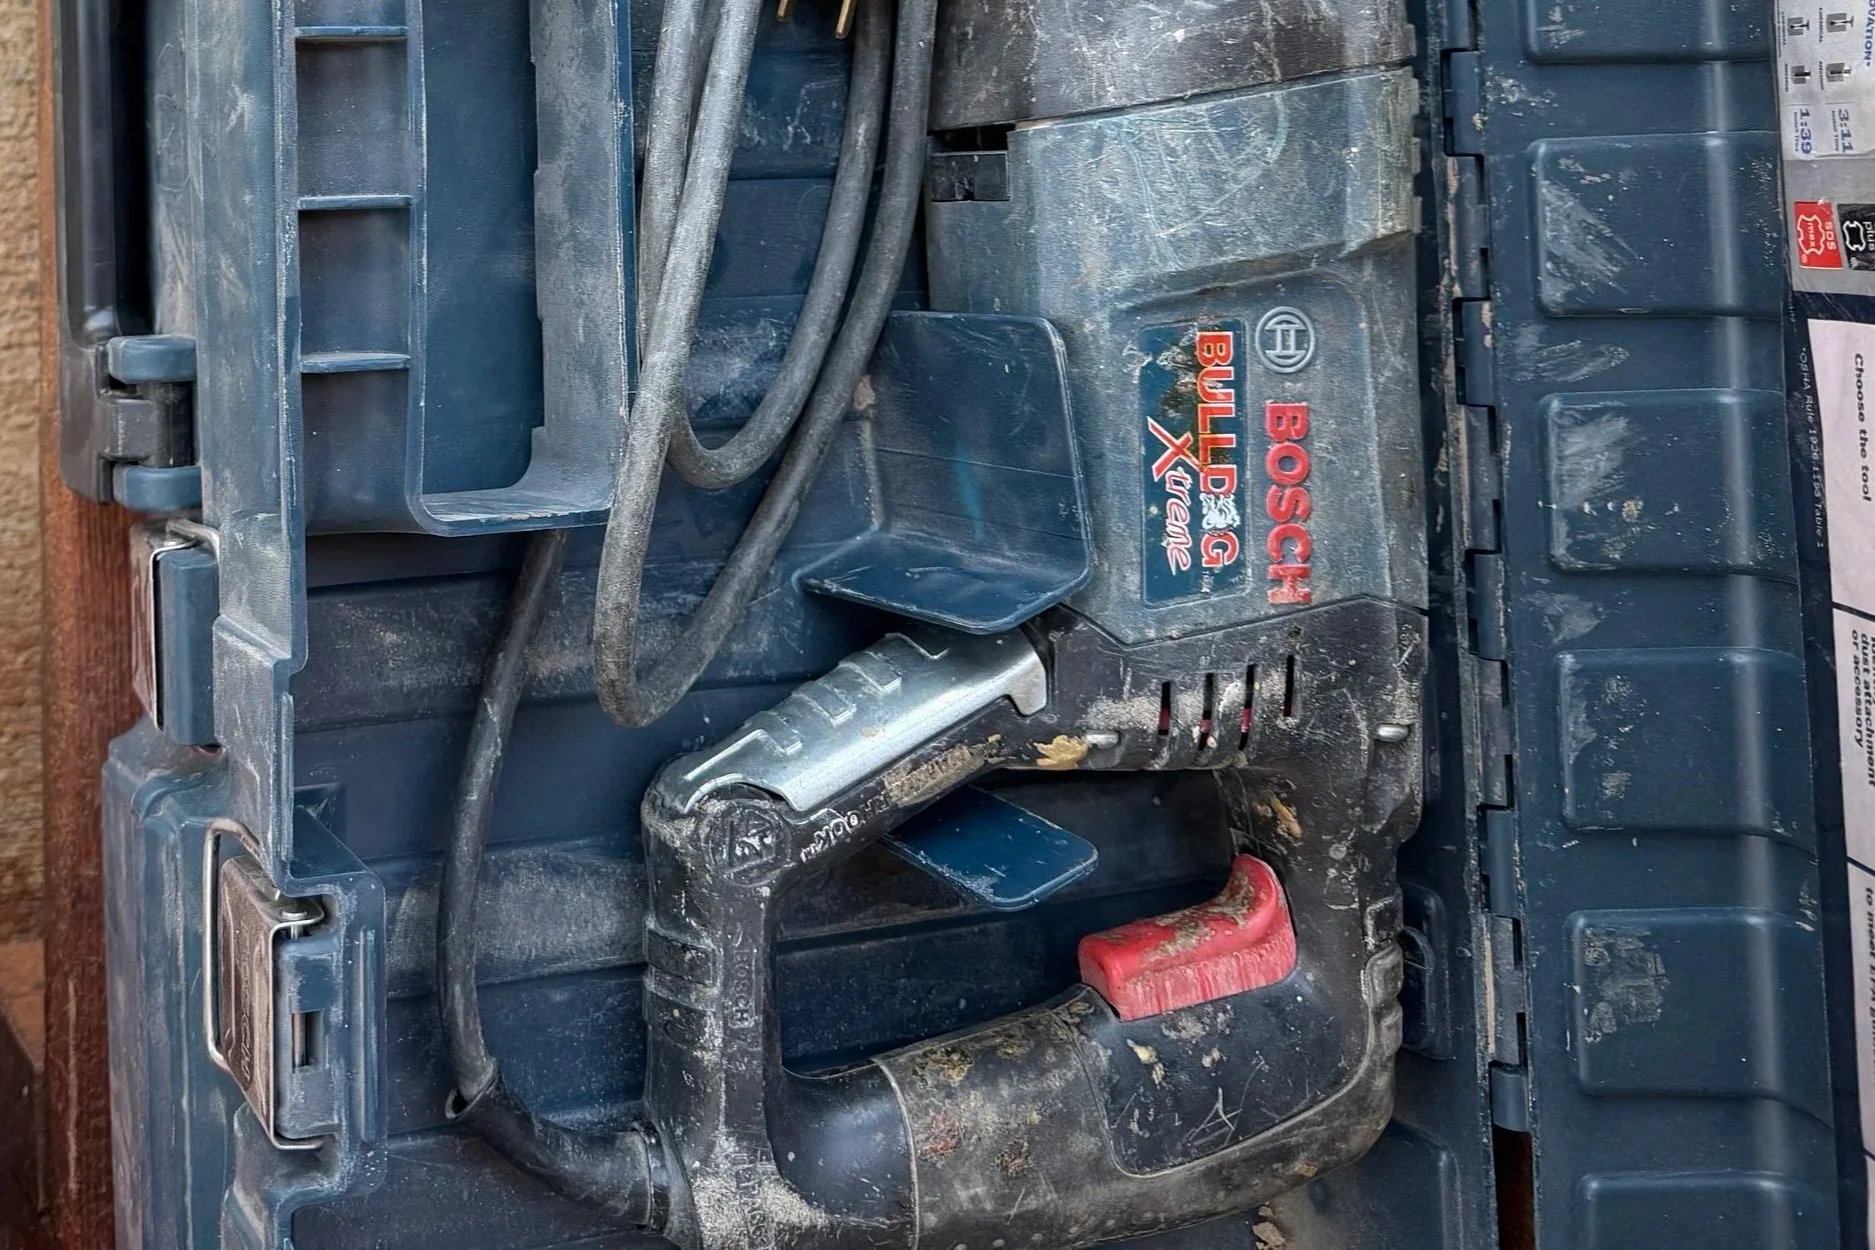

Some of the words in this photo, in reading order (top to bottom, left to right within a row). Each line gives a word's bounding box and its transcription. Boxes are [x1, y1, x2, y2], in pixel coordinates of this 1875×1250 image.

[1800, 108, 1812, 154] 1:39
[1838, 108, 1854, 153] 3:11
[1807, 222, 1815, 247] max
[1824, 222, 1836, 250] SDS
[1862, 222, 1875, 250] plus
[1854, 353, 1866, 423] Choose
[1859, 429, 1870, 458] the
[1805, 395, 1814, 423] Rule
[1814, 502, 1823, 536] Table
[1861, 466, 1872, 502] tool
[1146, 416, 1204, 576] Xtreme
[1265, 400, 1312, 604] BOSCH
[1852, 630, 1858, 650] or
[1862, 633, 1870, 674] dust
[1854, 654, 1864, 747] accessory
[1864, 679, 1875, 787] attachment
[1866, 887, 1874, 906] to
